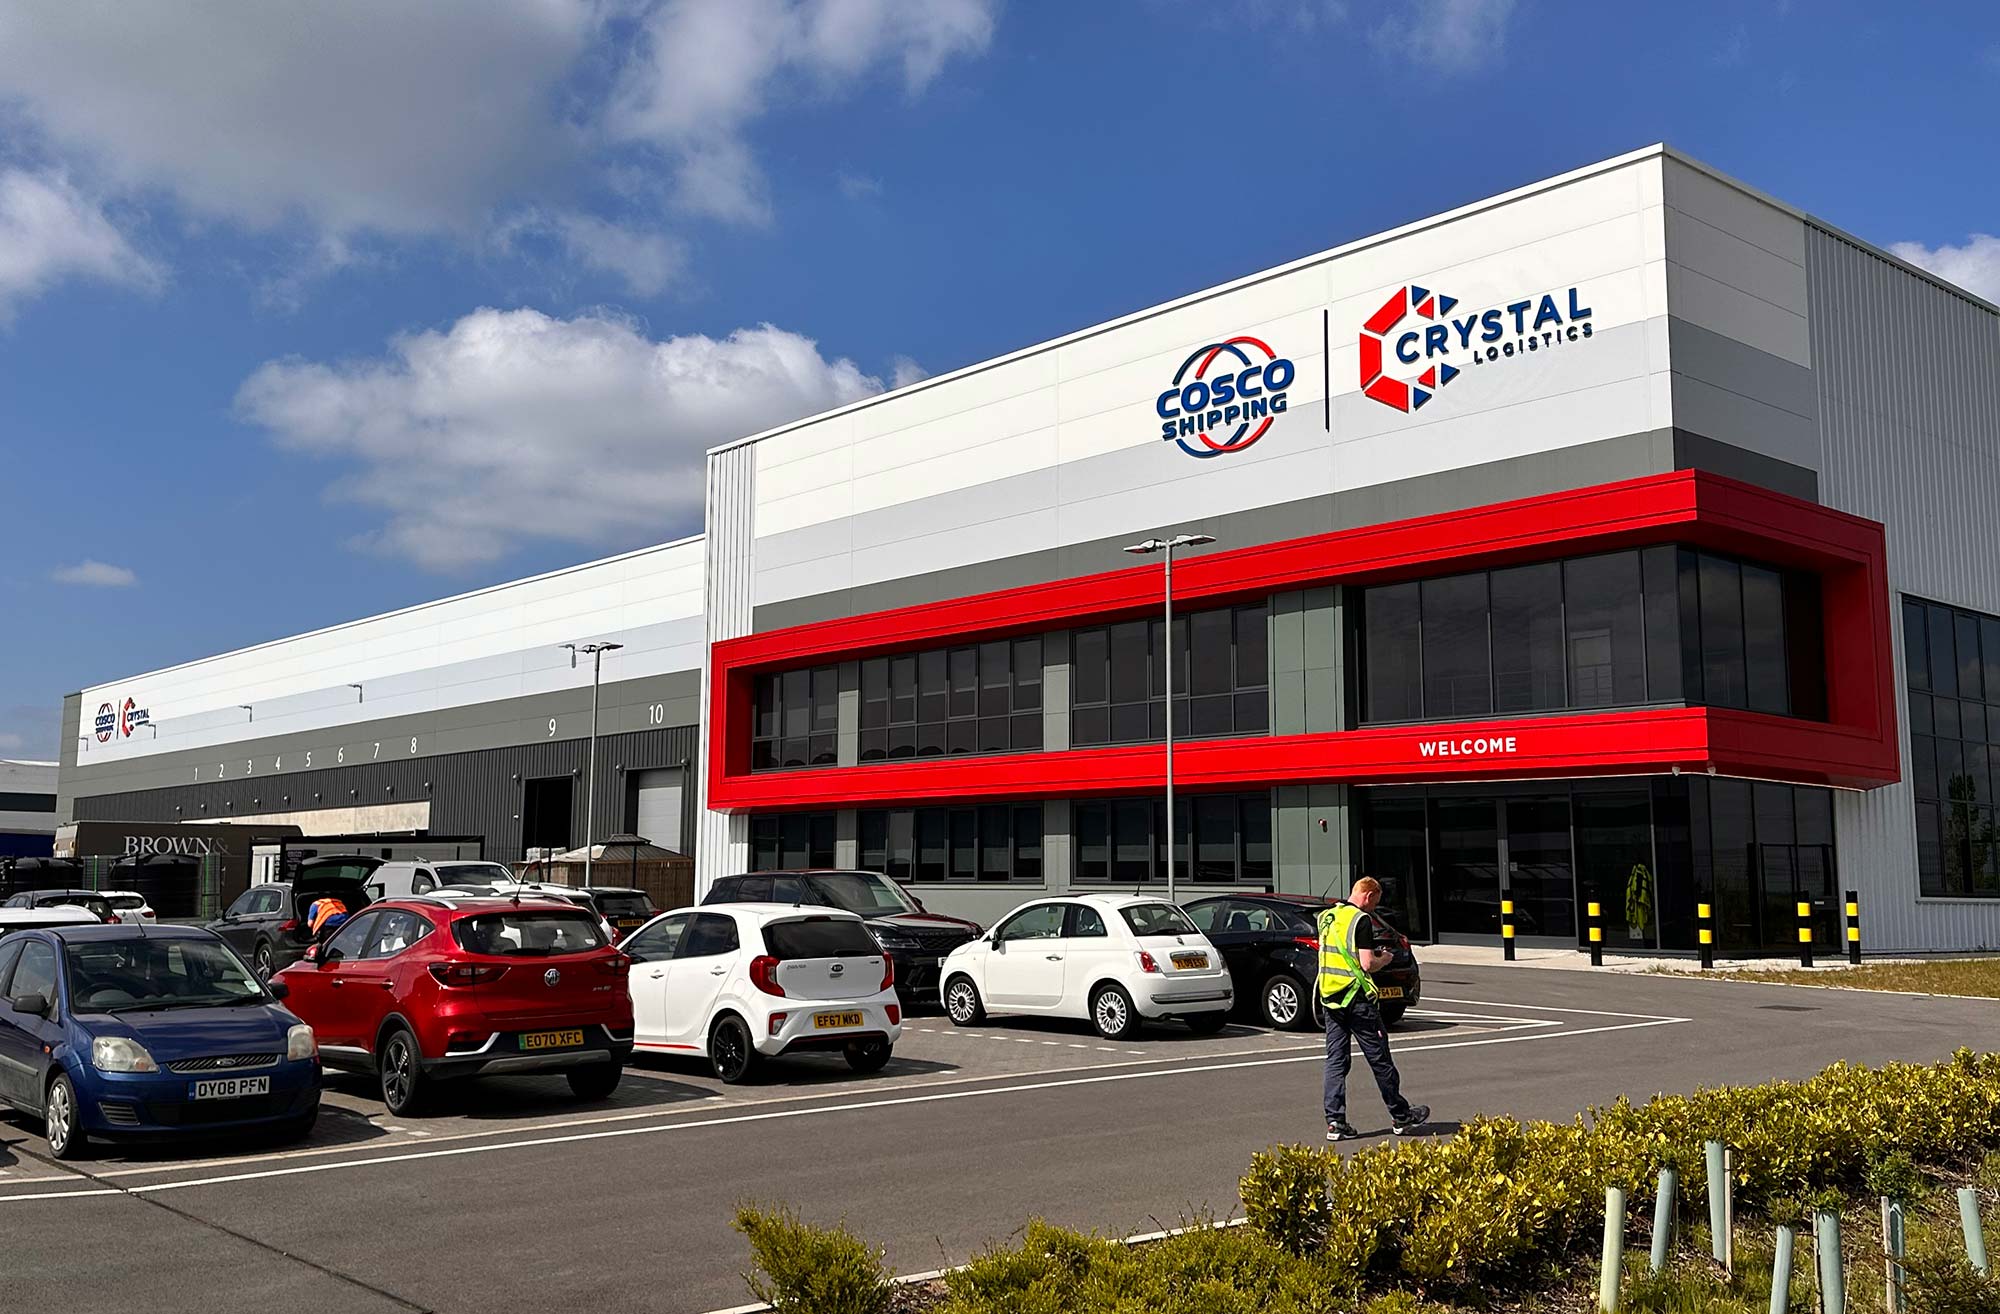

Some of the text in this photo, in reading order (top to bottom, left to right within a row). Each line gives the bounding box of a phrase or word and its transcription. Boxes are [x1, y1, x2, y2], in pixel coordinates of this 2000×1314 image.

[1395, 287, 1593, 364] CRYSTAL
[1473, 322, 1594, 365] LOGISTICS
[1156, 358, 1295, 418] COSCO
[1161, 392, 1288, 442] SHIPPING
[218, 763, 224, 778] 2
[246, 759, 253, 774] 3
[275, 756, 281, 771] 4
[305, 751, 312, 768] 5
[337, 747, 344, 763] 6
[373, 742, 380, 759] 7
[410, 736, 417, 754] 8
[548, 718, 556, 737] 9
[649, 703, 664, 724] 10
[1419, 737, 1517, 757] WELCOME
[123, 836, 212, 855] BROWN
[817, 1014, 841, 1027] EF67
[559, 1031, 581, 1044] XFC
[240, 1078, 267, 1093] PFN
